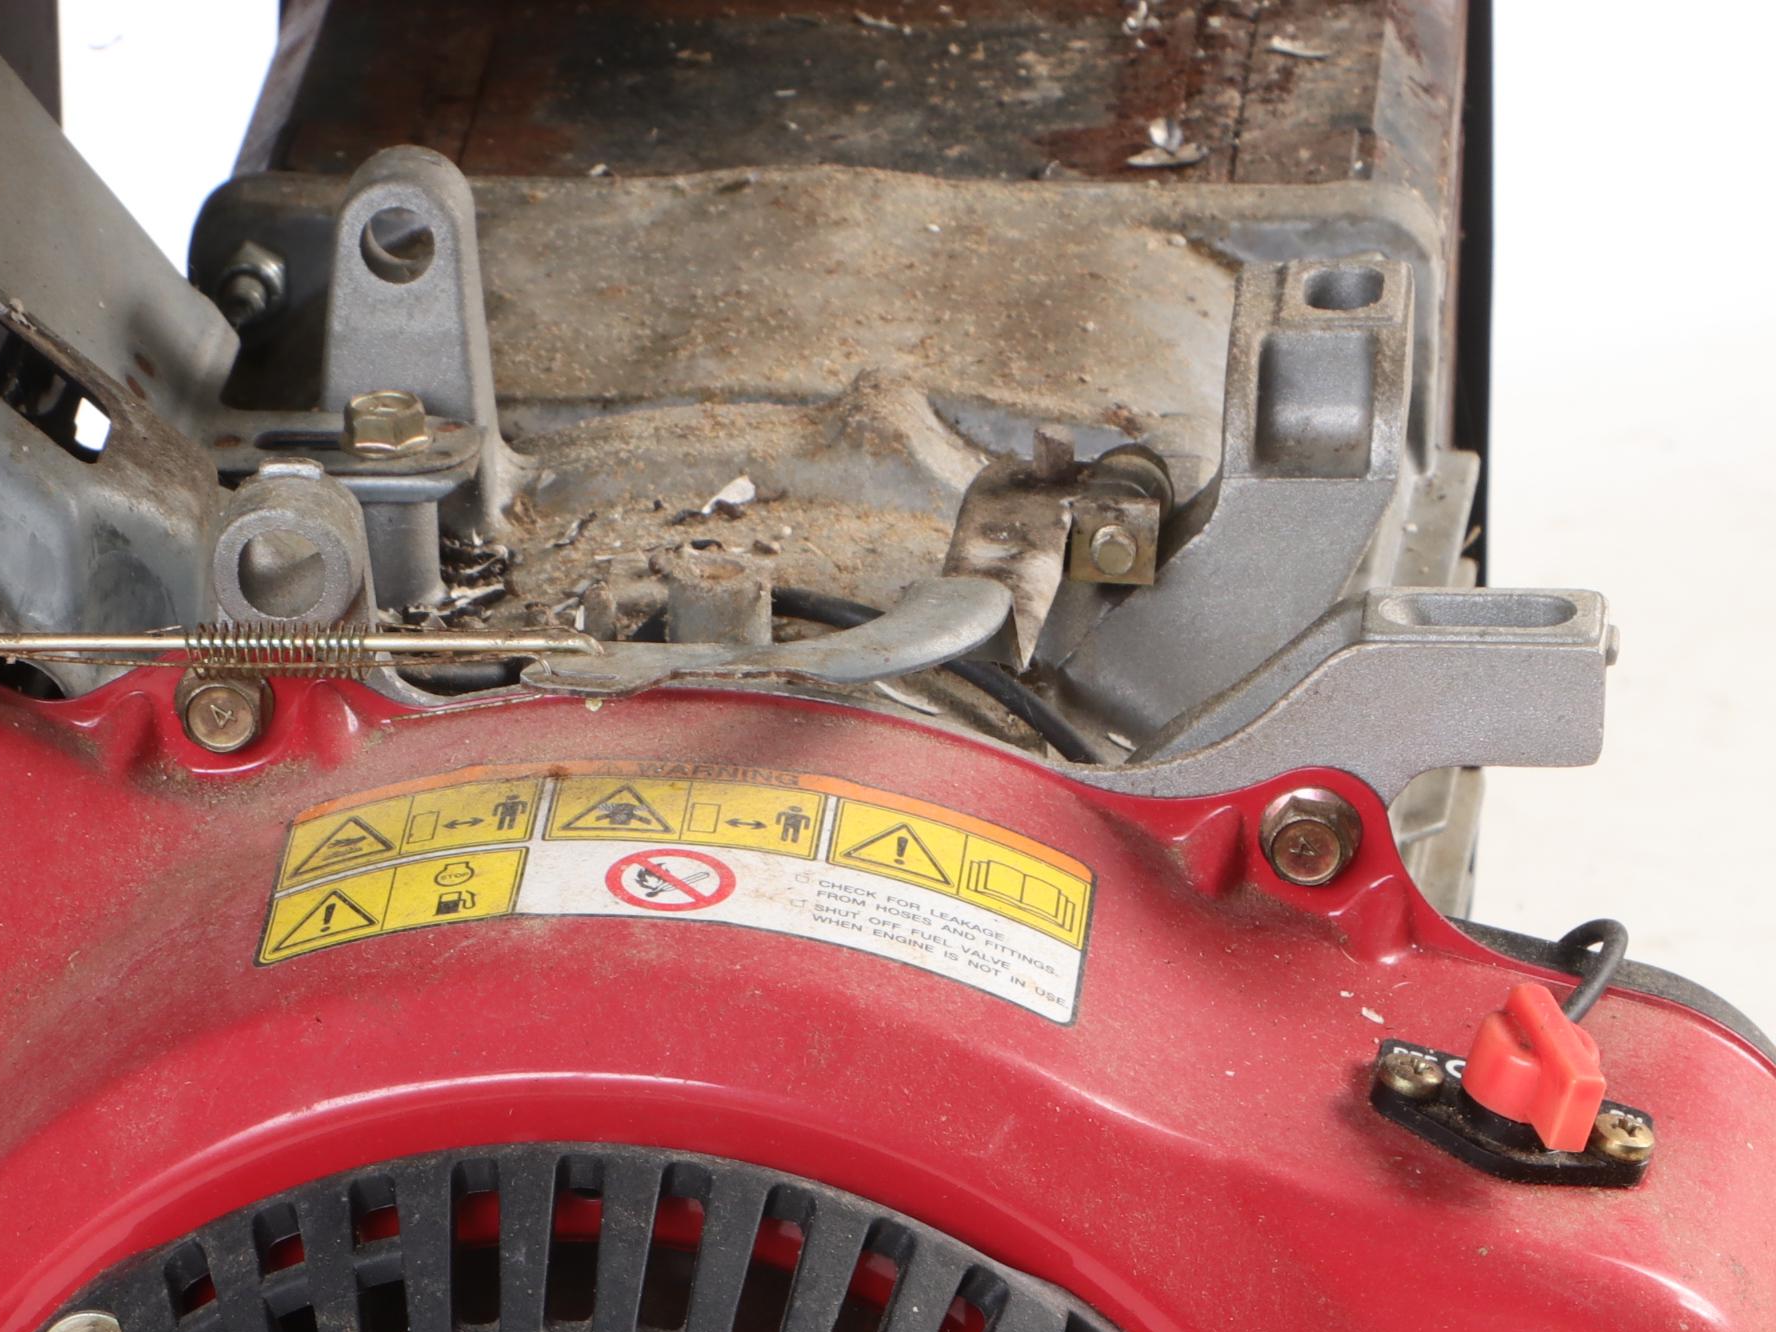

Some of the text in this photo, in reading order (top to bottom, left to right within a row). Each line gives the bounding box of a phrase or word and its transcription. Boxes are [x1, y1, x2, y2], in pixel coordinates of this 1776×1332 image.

[638, 761, 800, 787] WARNING
[813, 903, 1011, 970] SHUT OFF FUEL VALVE
[816, 889, 1061, 977] FROM HOSES AND FITTINGS.
[818, 879, 1006, 941] CHECK FOR LEAKAGE
[811, 913, 1070, 1010] WHEN ENGINE IS NOT IN USE.
